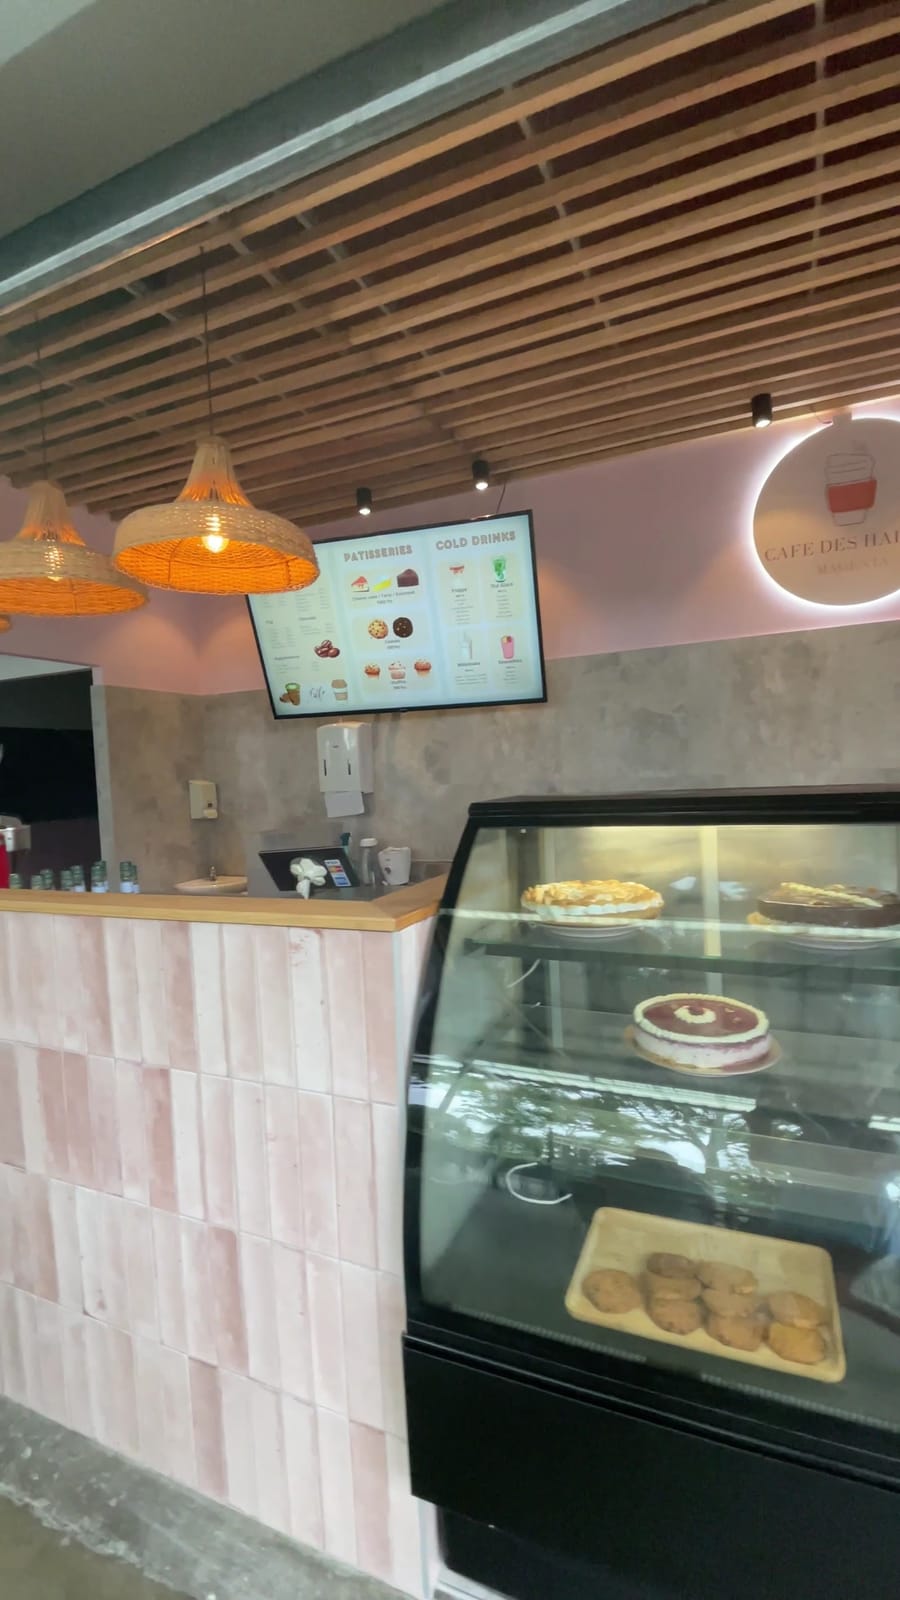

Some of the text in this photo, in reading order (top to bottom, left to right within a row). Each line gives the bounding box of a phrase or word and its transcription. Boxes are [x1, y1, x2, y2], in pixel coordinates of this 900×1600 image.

[436, 530, 516, 550] COLD DRINKS
[764, 542, 814, 561] CAFE
[820, 536, 857, 554] DES
[343, 545, 413, 562] PATISSERIES
